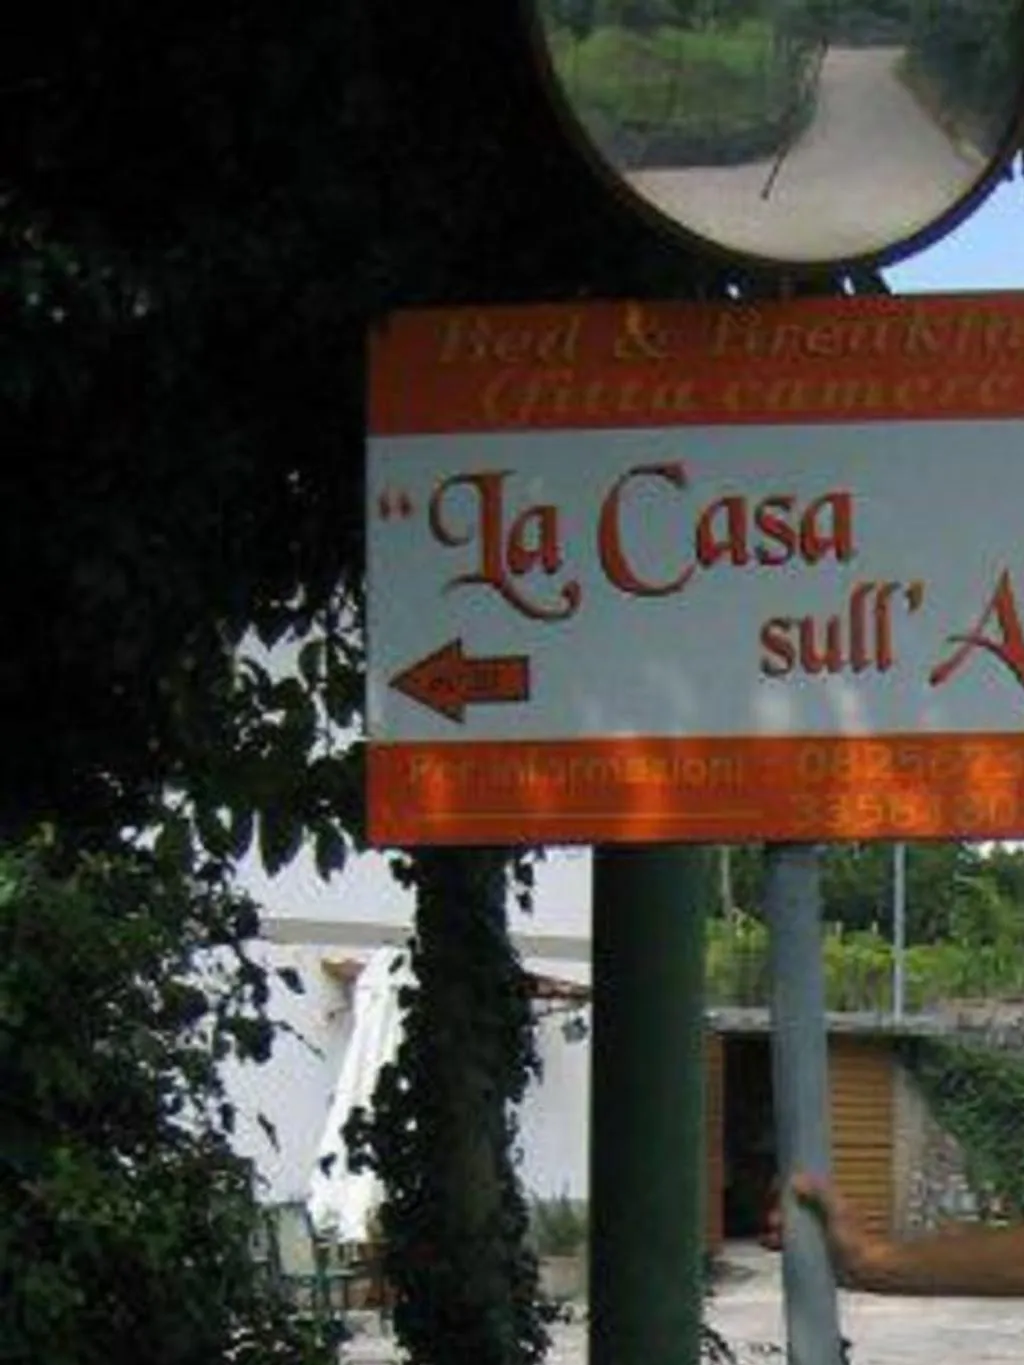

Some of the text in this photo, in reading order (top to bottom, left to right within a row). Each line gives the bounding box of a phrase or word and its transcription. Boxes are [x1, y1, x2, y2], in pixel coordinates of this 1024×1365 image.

[436, 312, 582, 362] Bed
[612, 300, 676, 358] &
[597, 461, 855, 597] Casa
